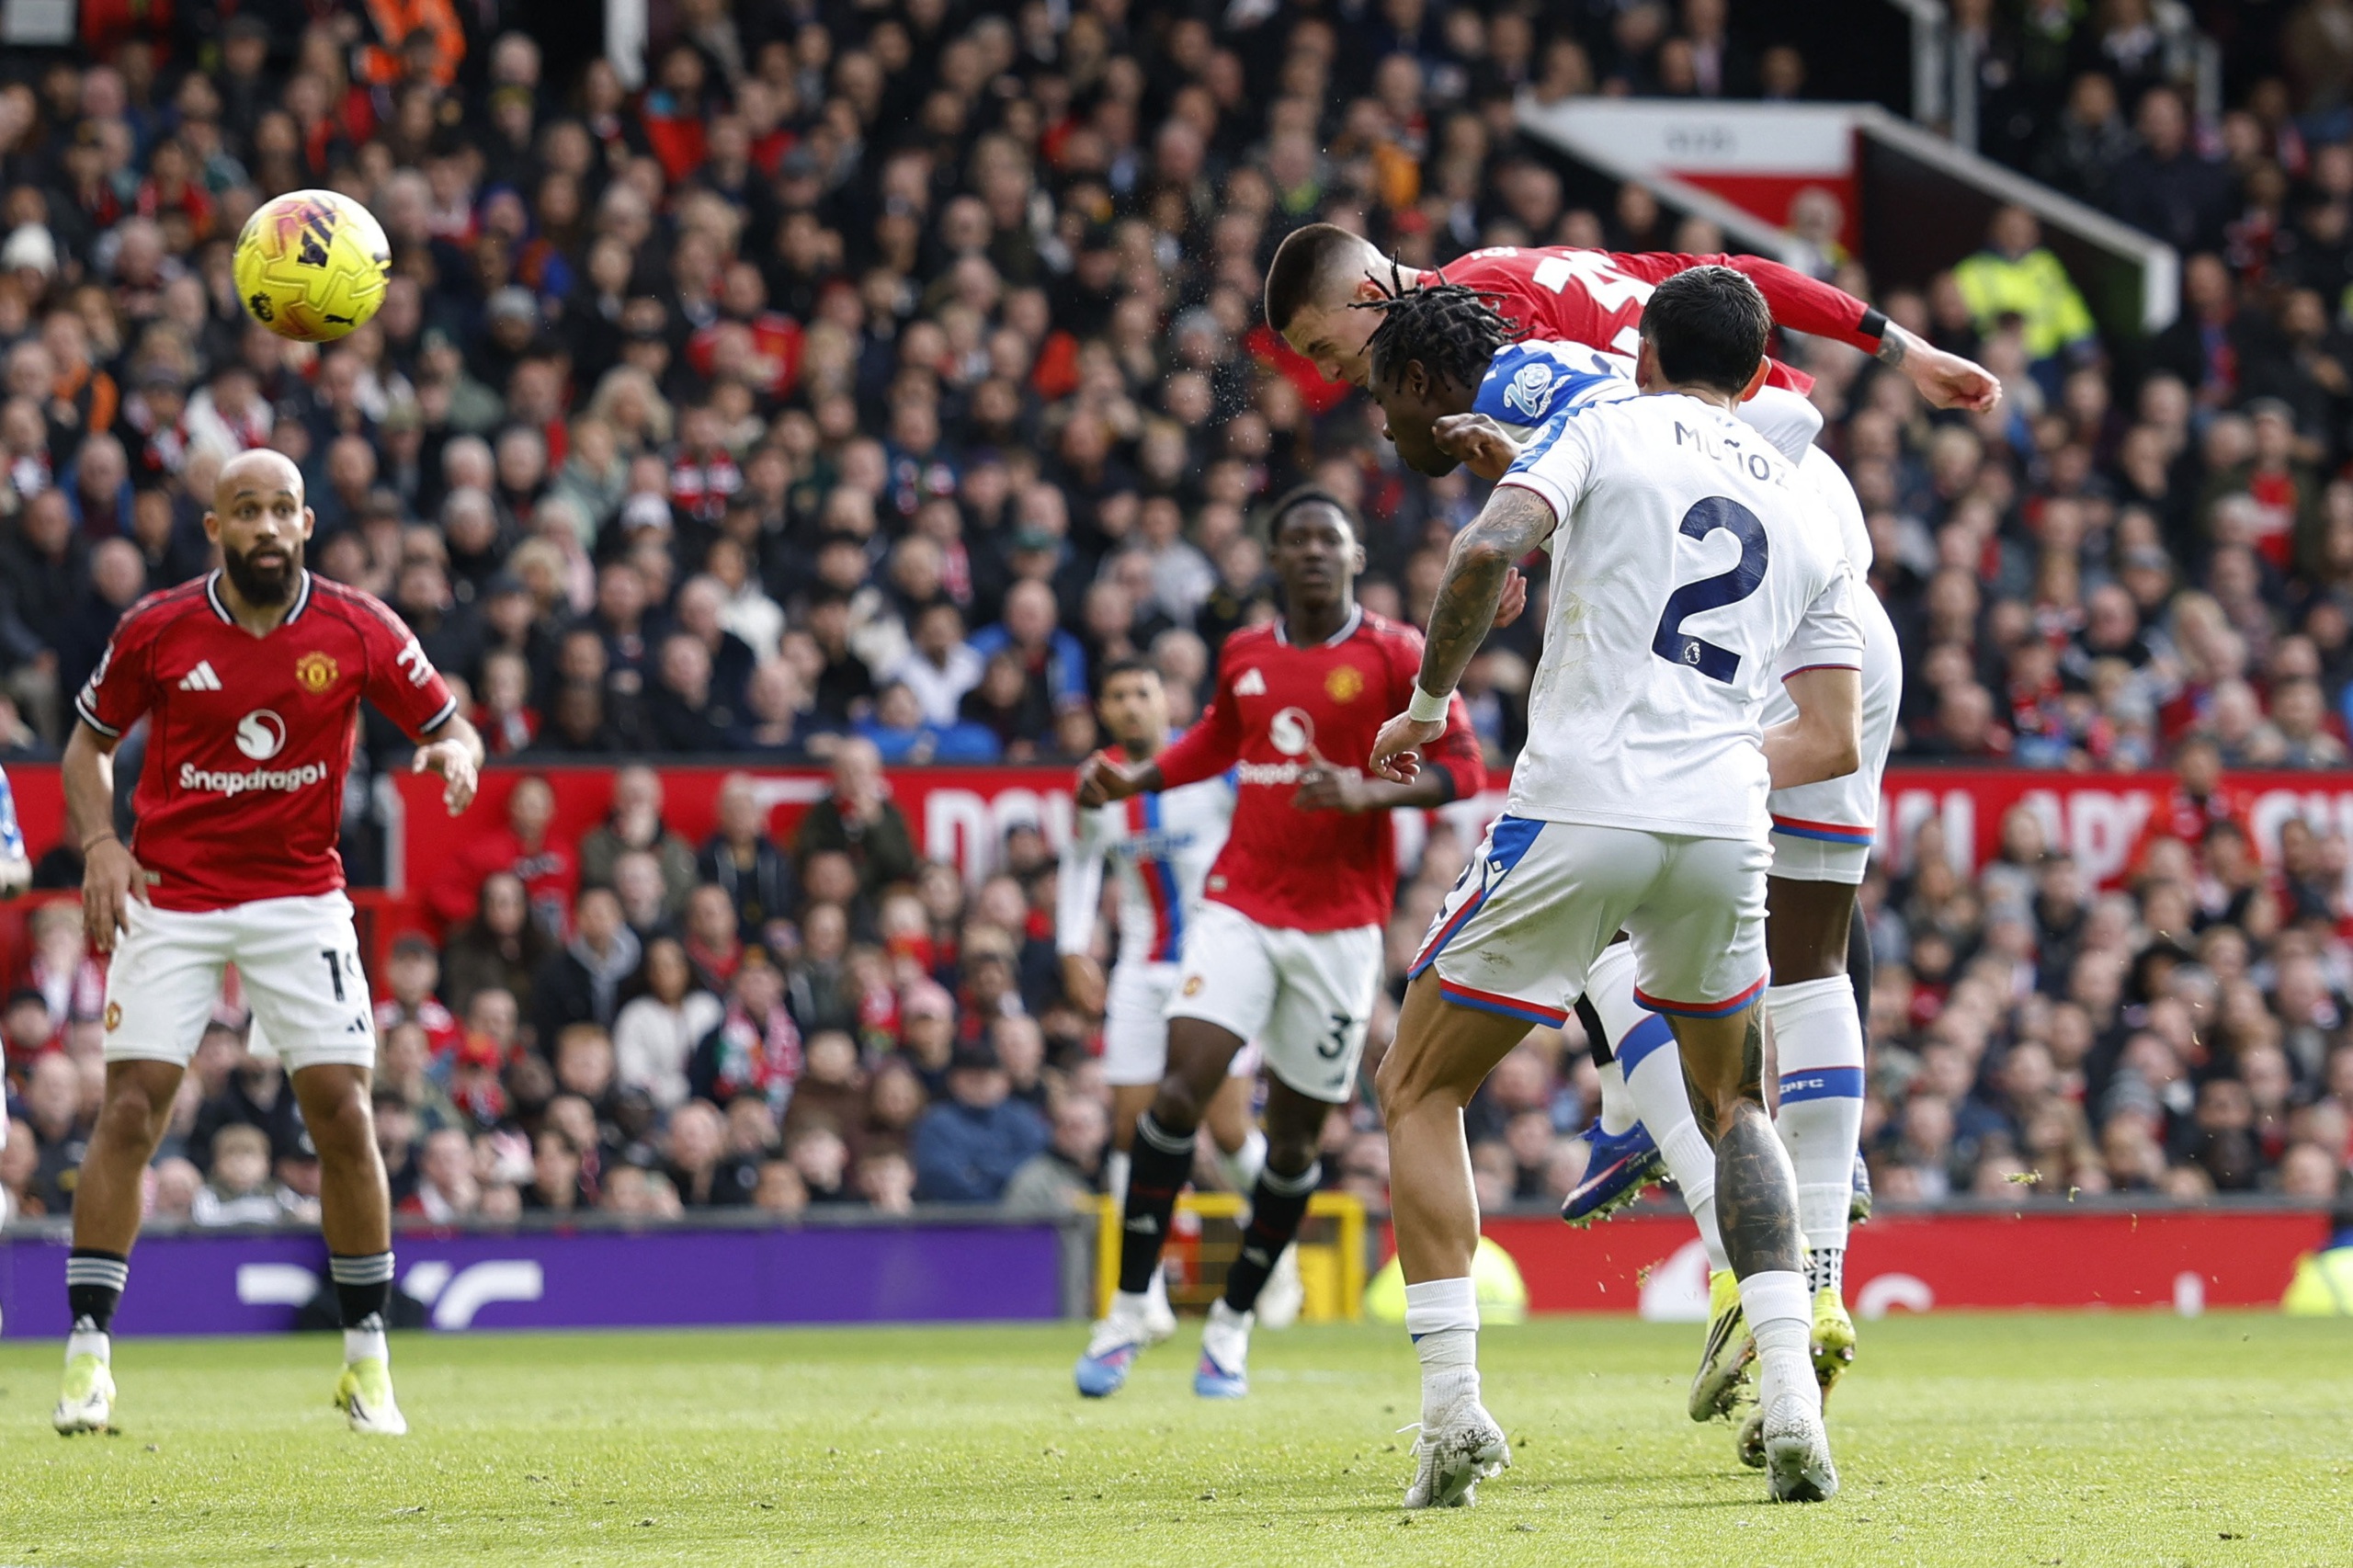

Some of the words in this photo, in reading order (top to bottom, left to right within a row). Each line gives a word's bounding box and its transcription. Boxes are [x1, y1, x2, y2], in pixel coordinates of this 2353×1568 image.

[1674, 420, 1790, 492] MUÑOZ
[1652, 495, 1768, 685] 2
[1316, 1013, 1353, 1061] 3
